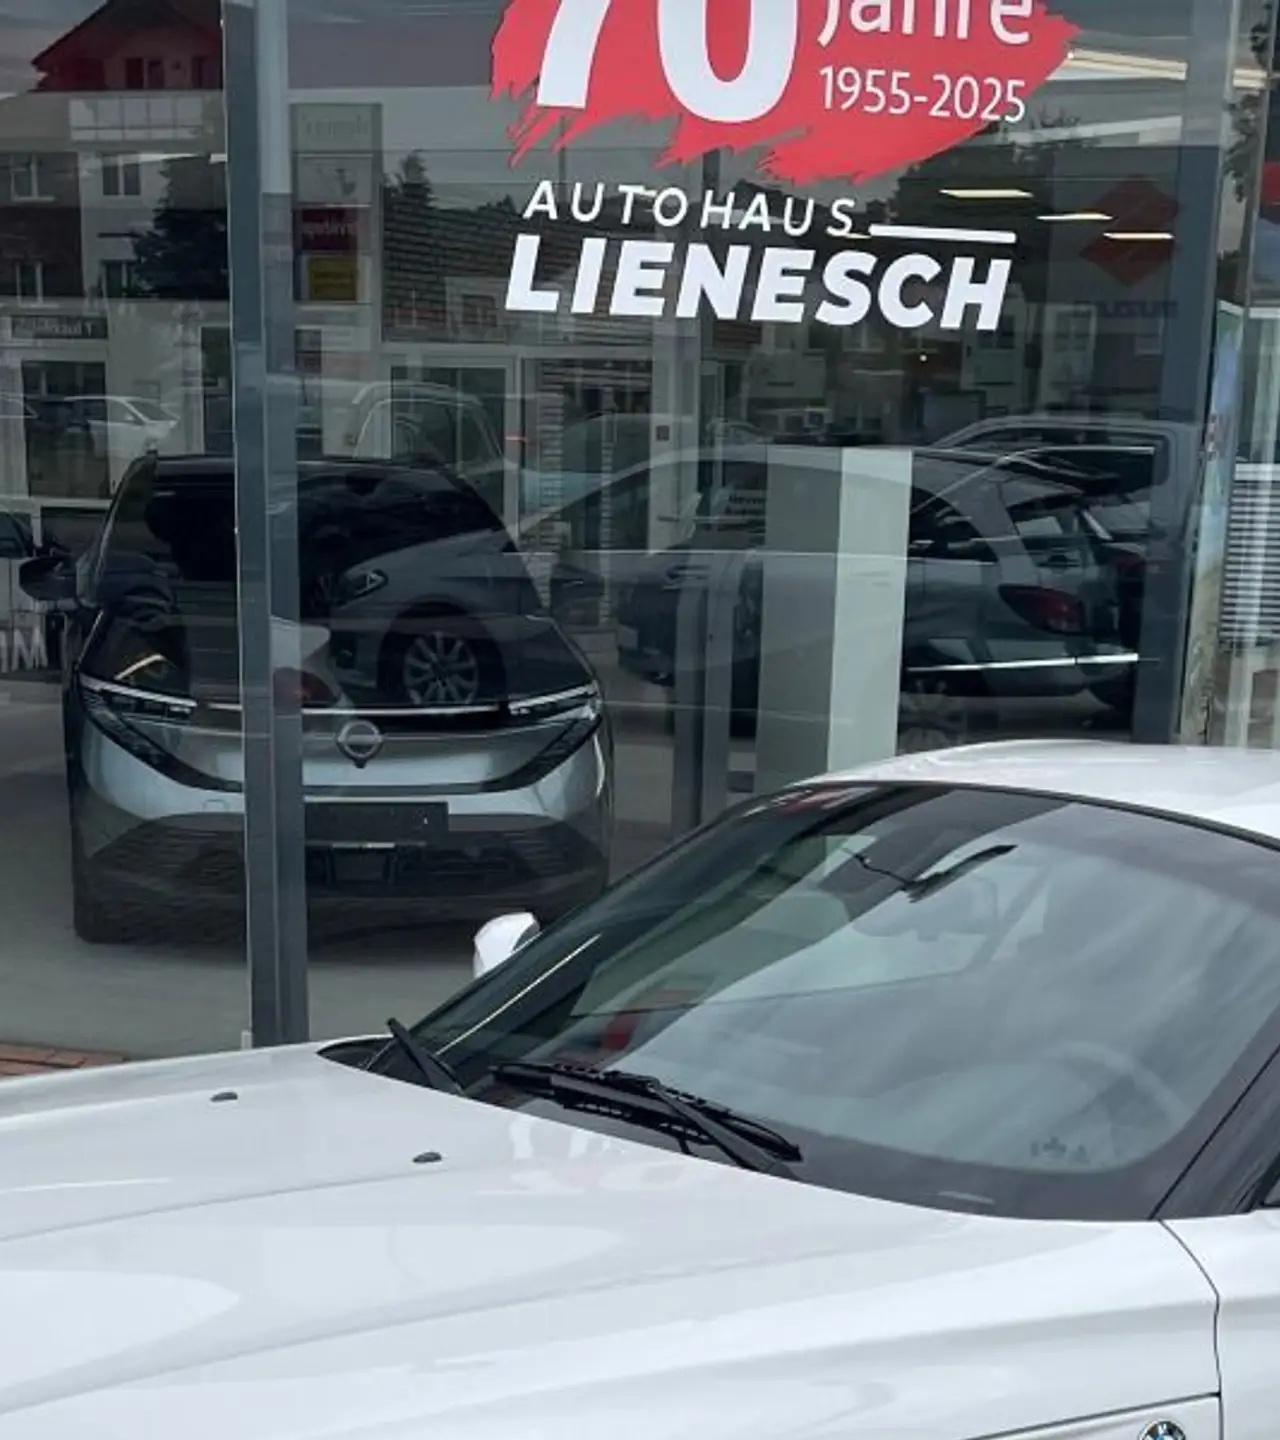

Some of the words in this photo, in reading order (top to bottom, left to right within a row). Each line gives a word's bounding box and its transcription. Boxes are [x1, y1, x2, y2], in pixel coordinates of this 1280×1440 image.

[819, 65, 1027, 123] 1955-2025
[522, 179, 857, 238] AUTOHAUS
[504, 232, 1012, 331] LIENESCH
